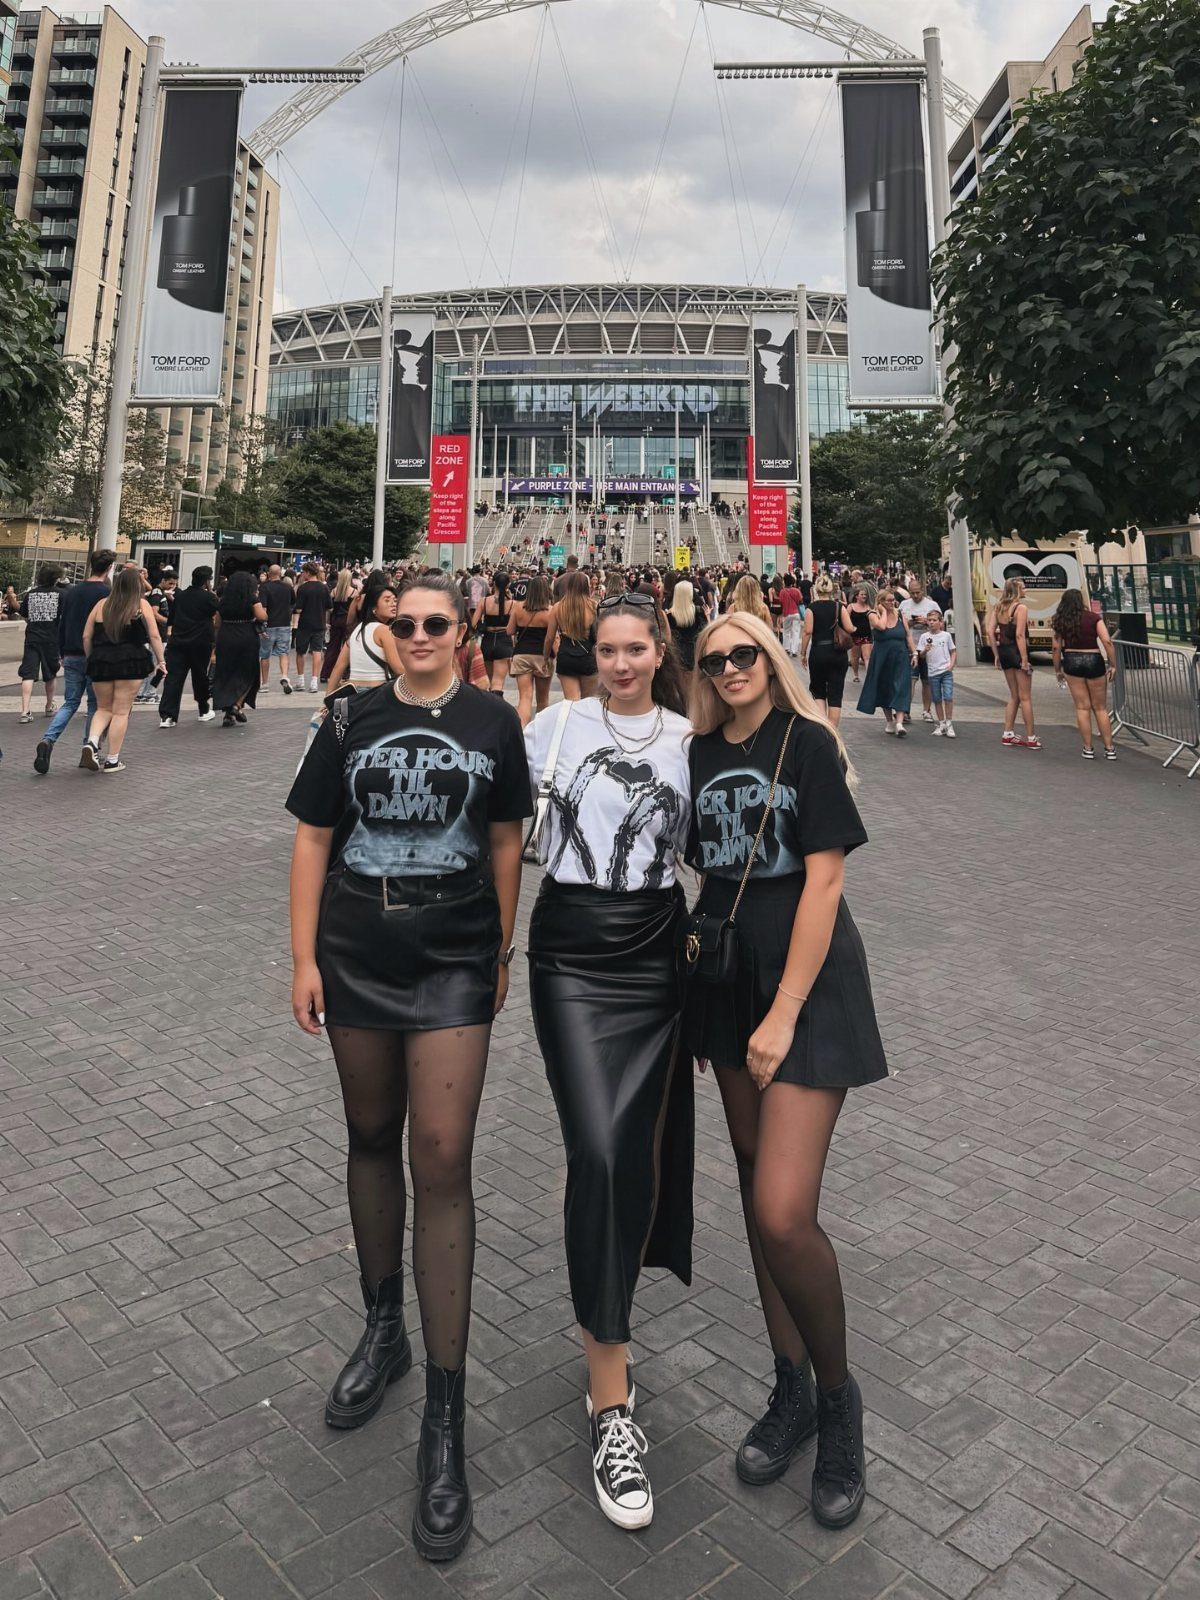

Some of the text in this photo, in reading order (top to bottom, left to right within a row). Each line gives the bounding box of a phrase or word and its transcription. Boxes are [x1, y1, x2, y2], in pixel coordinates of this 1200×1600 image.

[150, 355, 211, 366] TOM FORD
[861, 355, 924, 366] TOM FORD
[511, 381, 720, 423] THE WEEKND
[435, 456, 464, 465] ZONE
[439, 444, 461, 453] RED
[528, 481, 562, 491] PURPLE
[615, 481, 638, 491] MAIN
[640, 482, 685, 492] ENTRANE
[389, 768, 433, 795] TIL
[367, 792, 451, 825] DAWN
[734, 782, 799, 818] HOUR
[715, 812, 746, 840] TIL
[700, 833, 768, 869] DAWN
